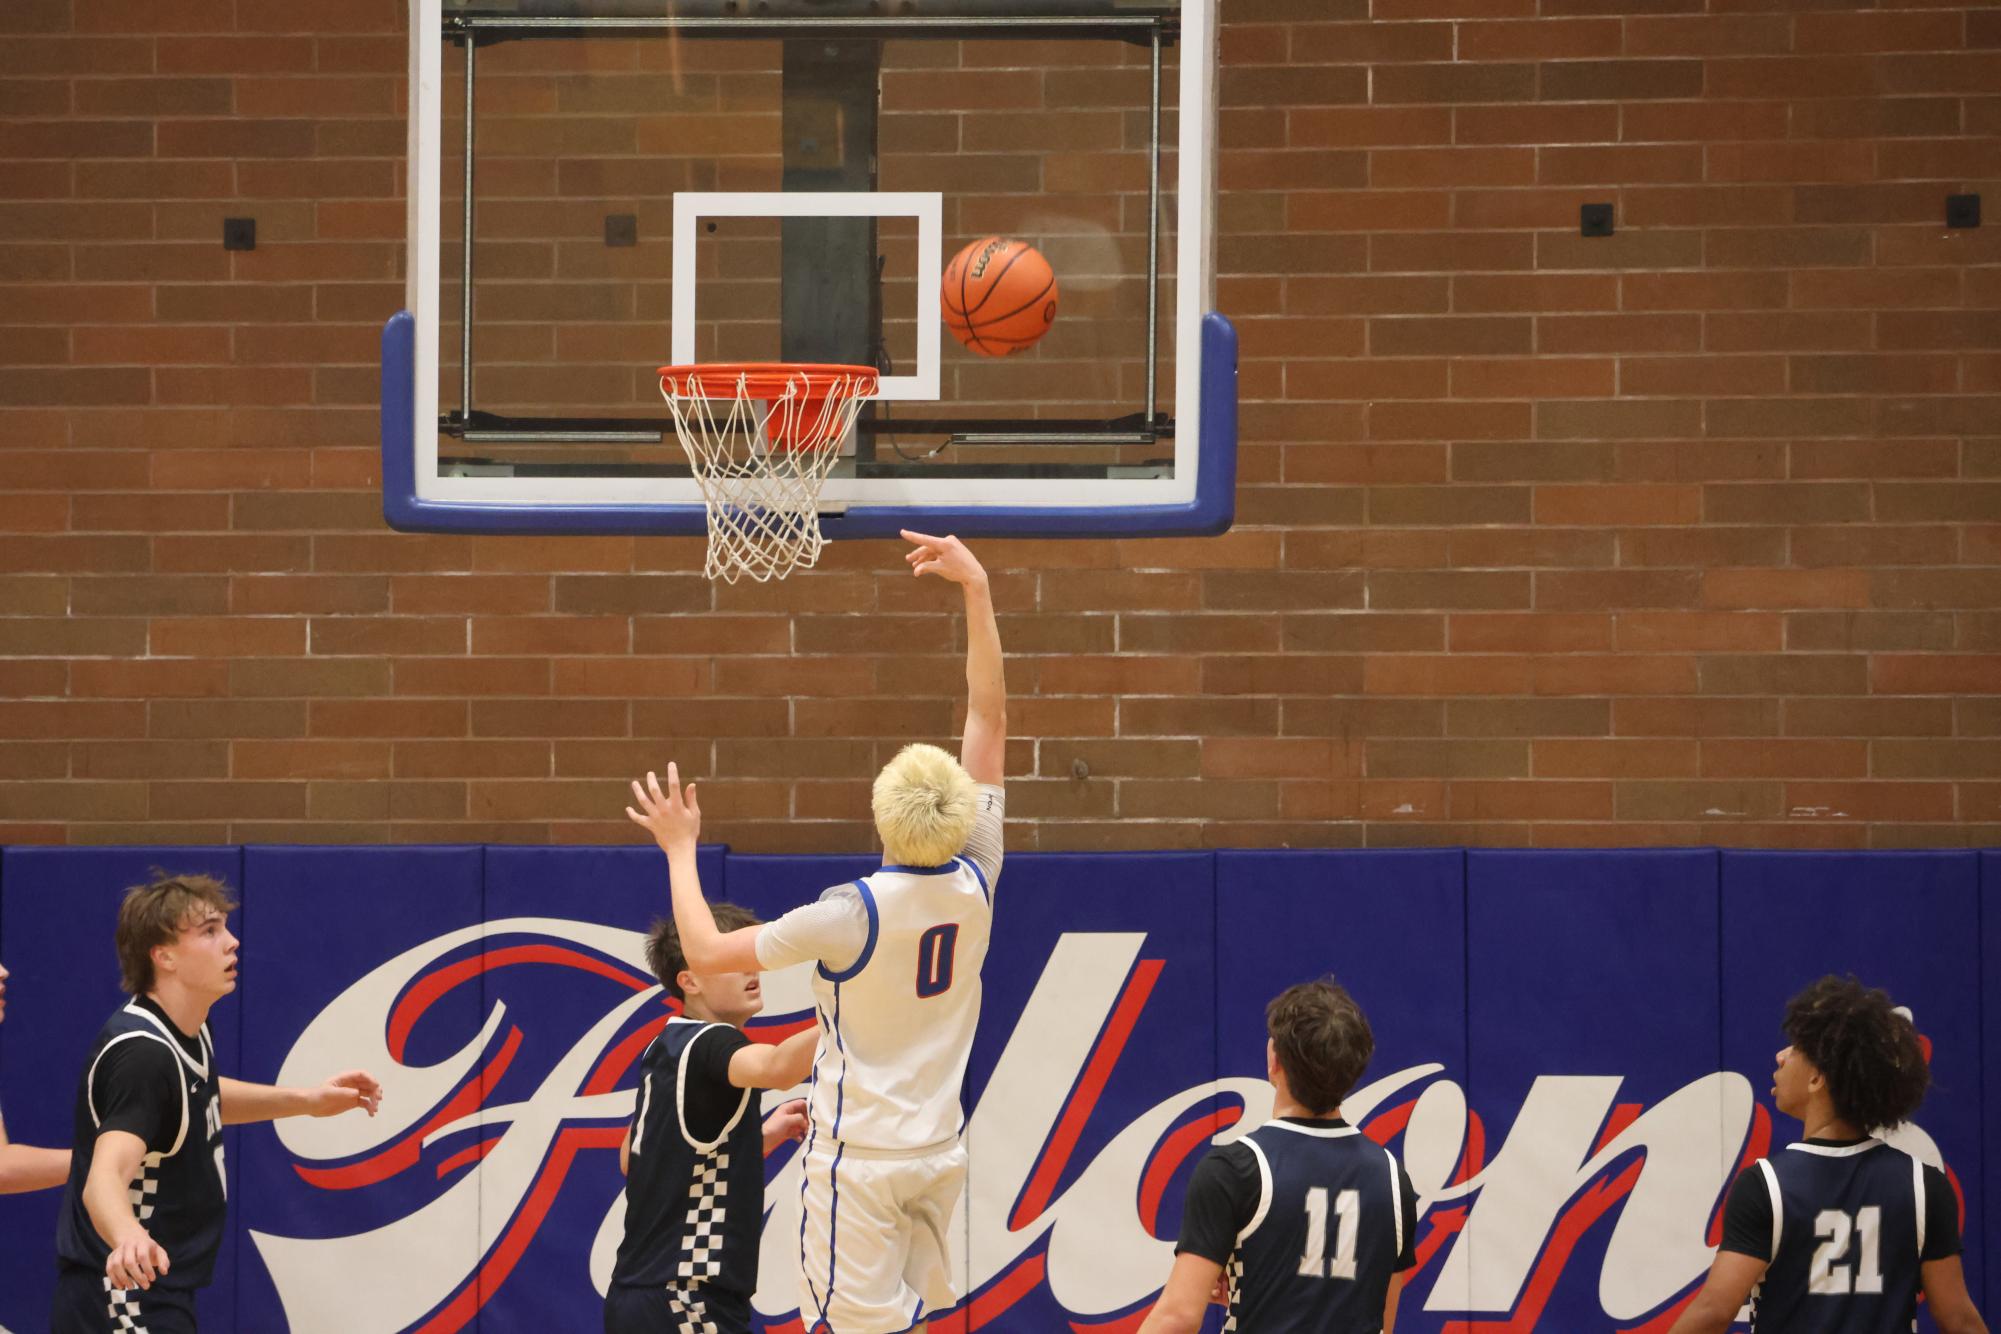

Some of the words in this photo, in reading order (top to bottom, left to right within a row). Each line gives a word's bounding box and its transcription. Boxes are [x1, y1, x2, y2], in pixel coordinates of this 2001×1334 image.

[916, 923, 959, 999] 0
[1297, 1186, 1360, 1280] 11
[1808, 1205, 1883, 1295] 21
